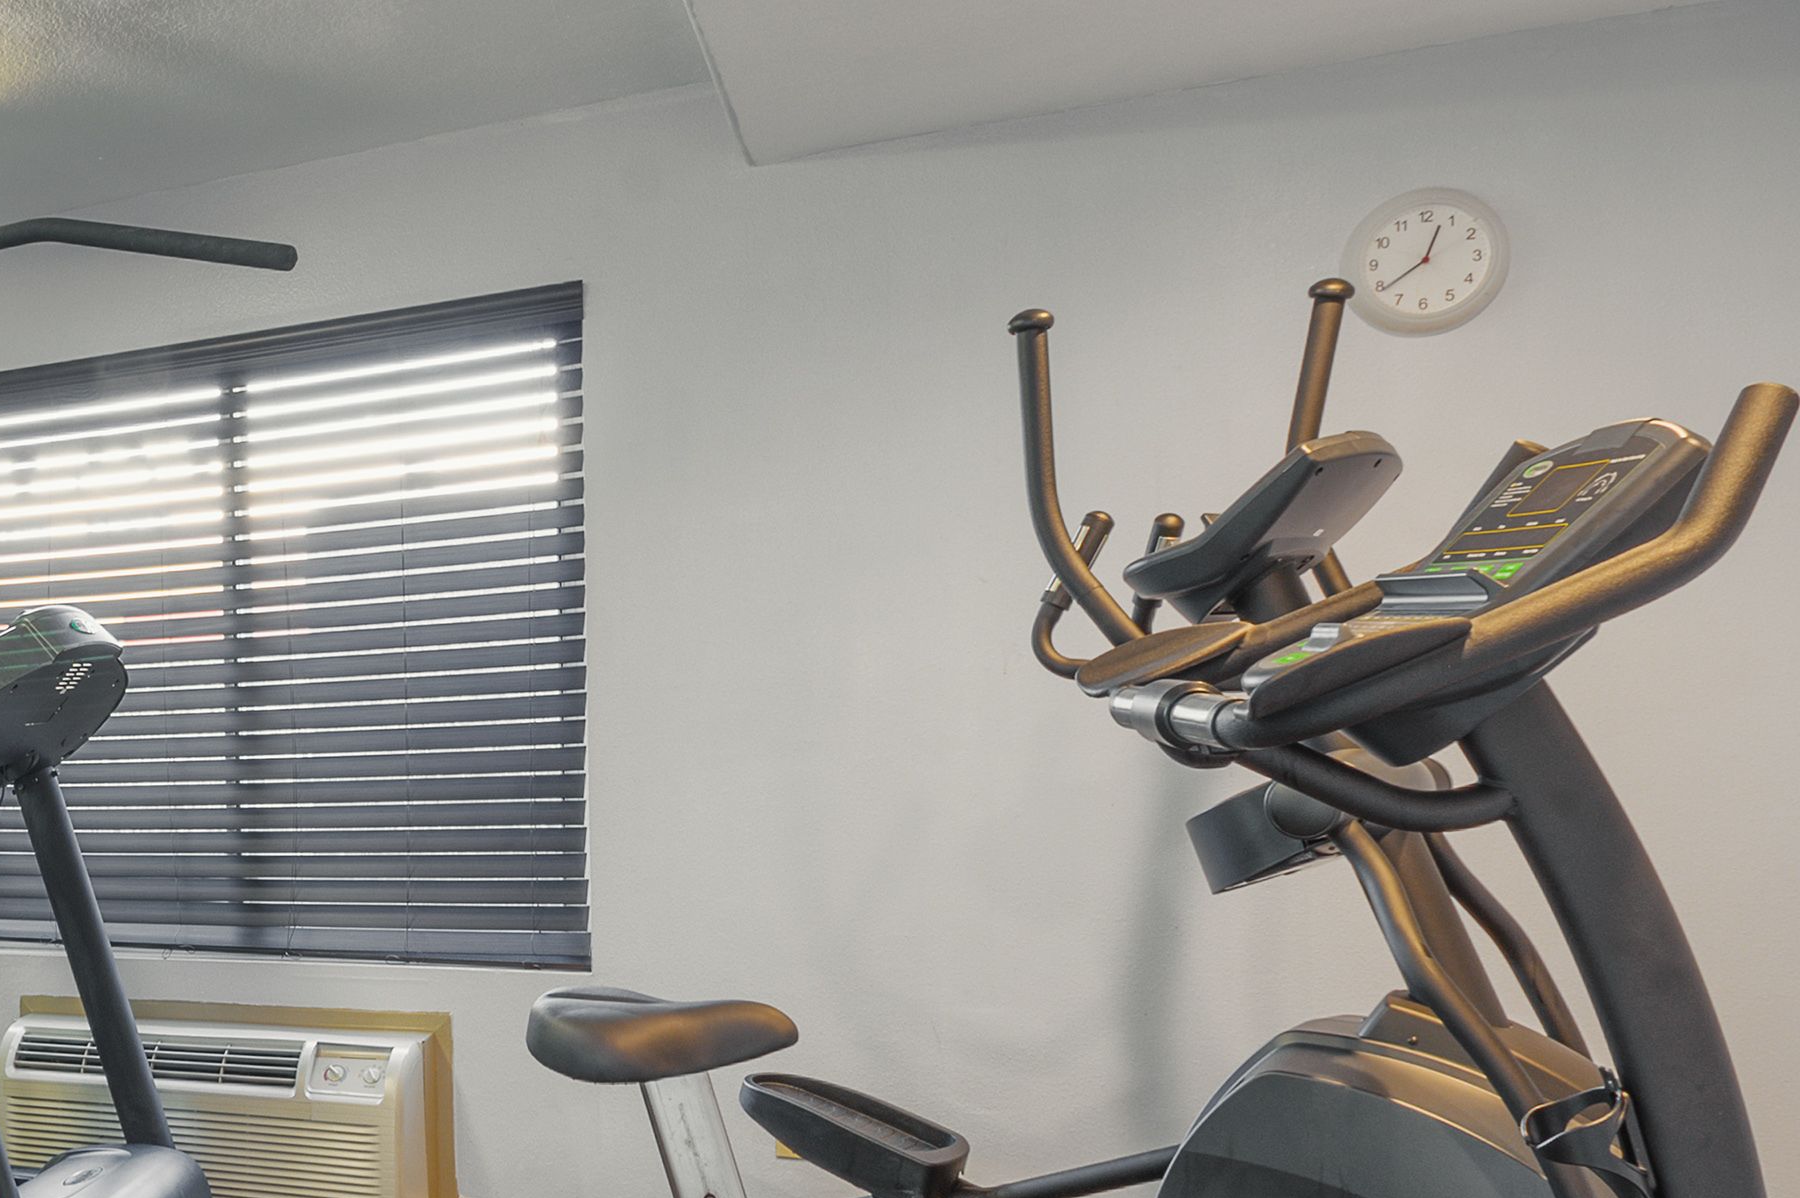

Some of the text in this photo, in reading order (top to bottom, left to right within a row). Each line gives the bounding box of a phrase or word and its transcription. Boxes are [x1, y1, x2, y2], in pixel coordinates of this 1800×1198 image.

[1419, 210, 1433, 223] 12
[1448, 215, 1455, 227] 1
[1394, 220, 1407, 232] 11
[1466, 227, 1477, 240] 2
[1376, 236, 1390, 249] 10
[1472, 249, 1482, 262] 3
[1369, 259, 1378, 271] 9
[1464, 272, 1473, 284] 4
[1375, 280, 1385, 292] 8
[1394, 294, 1404, 305] 7
[1445, 289, 1455, 301] 5
[1418, 297, 1428, 310] 6
